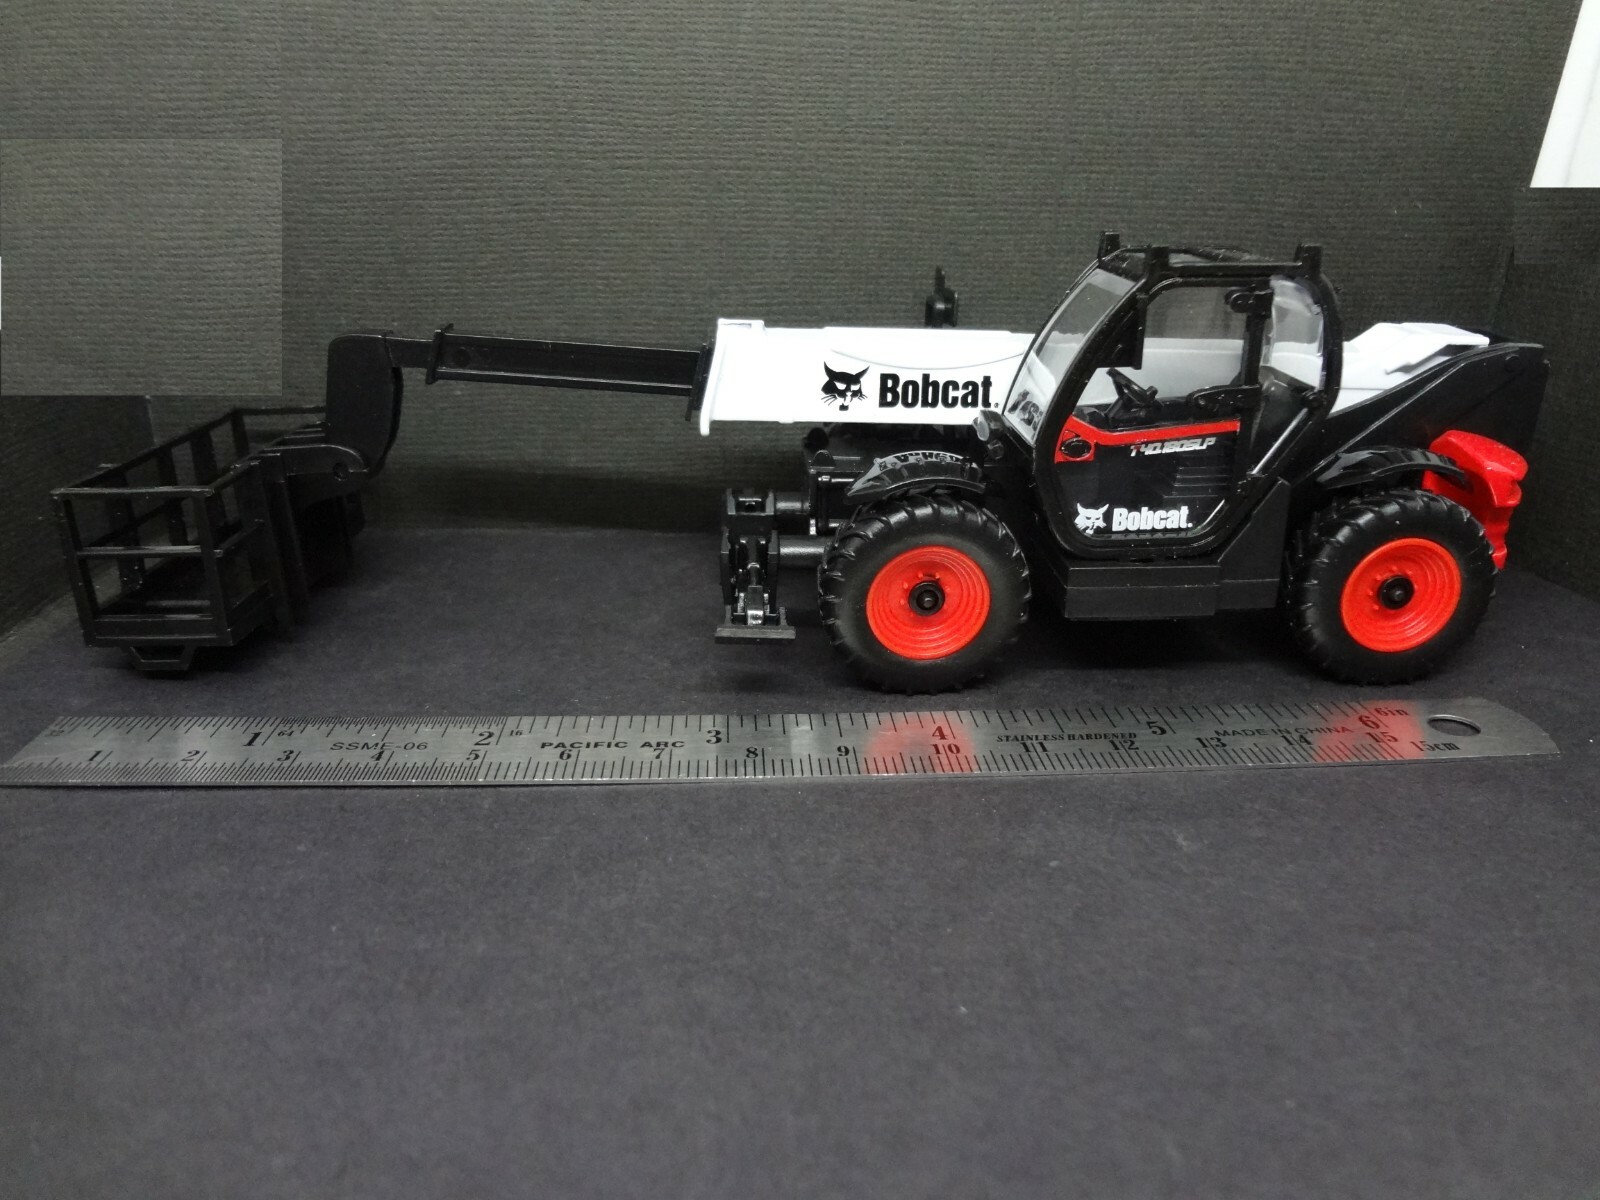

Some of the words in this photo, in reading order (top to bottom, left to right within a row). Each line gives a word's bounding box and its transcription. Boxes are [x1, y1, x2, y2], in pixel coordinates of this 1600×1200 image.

[879, 373, 992, 408] Bobcat
[243, 732, 261, 747] 1
[474, 731, 495, 746] 2
[706, 730, 722, 745] 3
[931, 726, 948, 740] 4
[1146, 721, 1167, 735] 5
[1359, 715, 1380, 729] 6
[1375, 707, 1409, 717] 6in
[1214, 728, 1267, 738] MADE
[1271, 728, 1291, 736] IN
[1295, 726, 1354, 735] CHINA
[997, 734, 1064, 743] STAINLESS
[1068, 732, 1137, 741] HARDENED
[87, 750, 103, 762] 1
[181, 750, 201, 762] 2
[277, 750, 295, 762] 3
[370, 751, 385, 762] 4
[466, 750, 480, 761] 5
[559, 749, 573, 760] 6
[654, 748, 666, 760] 7
[747, 747, 759, 759] 8
[837, 746, 850, 757] 9
[931, 744, 961, 755] 10
[1410, 740, 1461, 751] 15cm
[330, 742, 428, 751] SSME-06
[541, 741, 629, 749] PACIFIC
